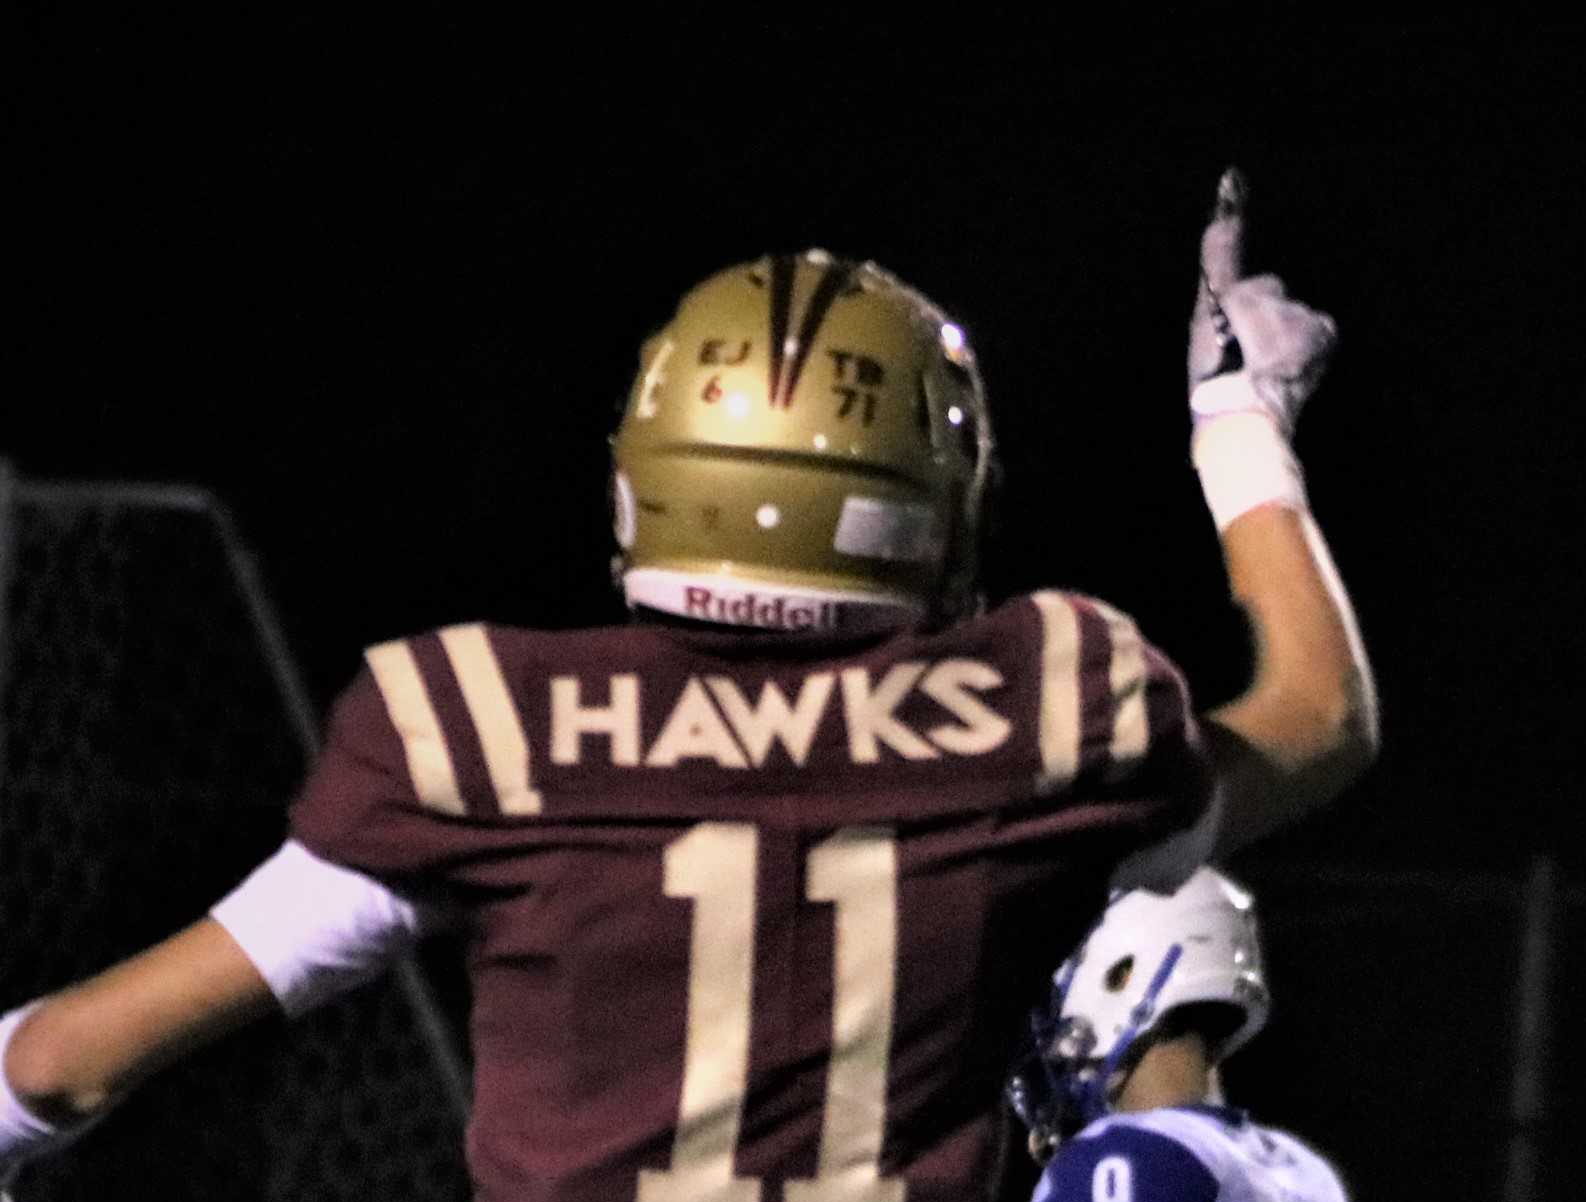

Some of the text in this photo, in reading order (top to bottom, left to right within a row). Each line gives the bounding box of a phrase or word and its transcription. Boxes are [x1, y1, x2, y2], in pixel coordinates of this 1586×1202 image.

[833, 387, 876, 427] 71
[685, 585, 848, 628] Riddell
[548, 660, 1013, 769] HAWKS
